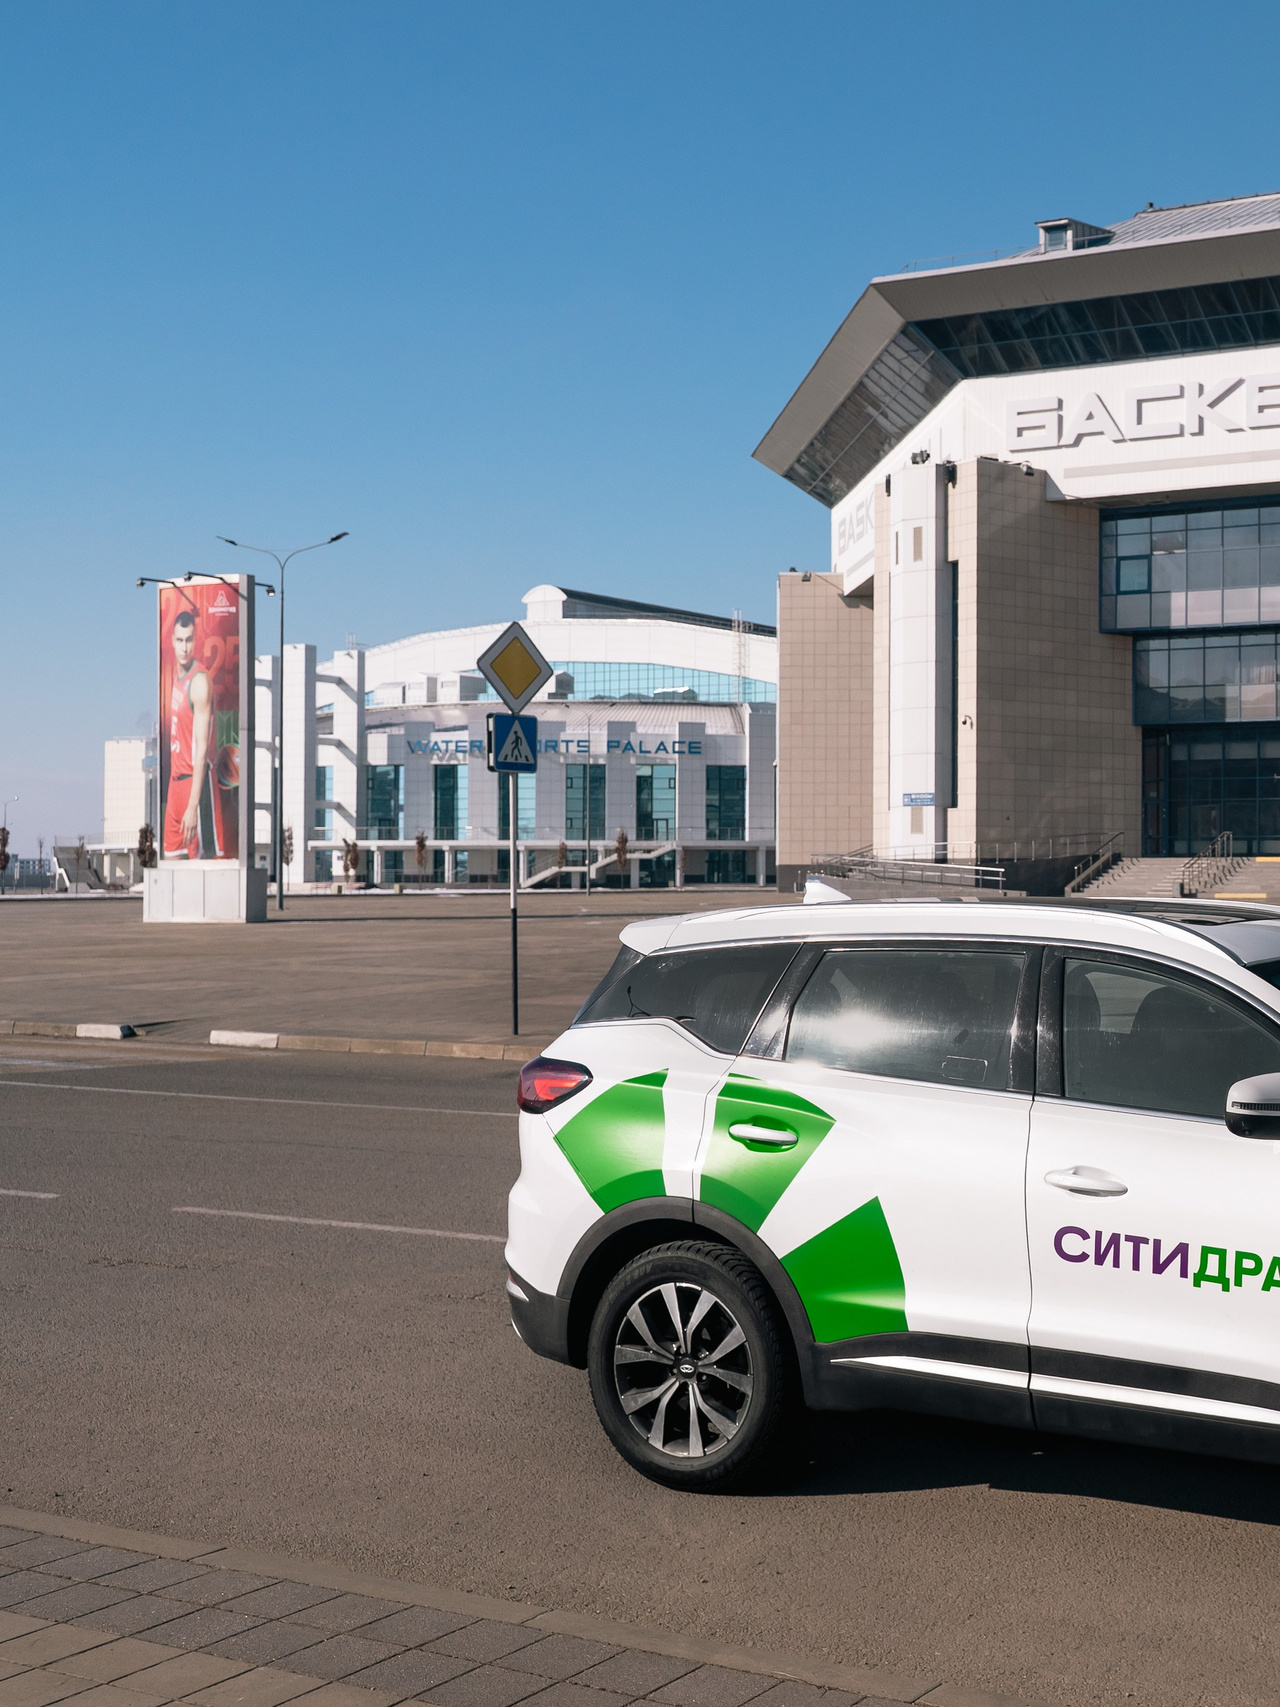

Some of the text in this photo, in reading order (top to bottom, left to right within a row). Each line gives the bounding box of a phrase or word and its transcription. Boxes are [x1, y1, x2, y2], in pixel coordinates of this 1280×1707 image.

[839, 491, 875, 556] BASK
[407, 740, 483, 755] WATER
[607, 740, 702, 755] PALACE
